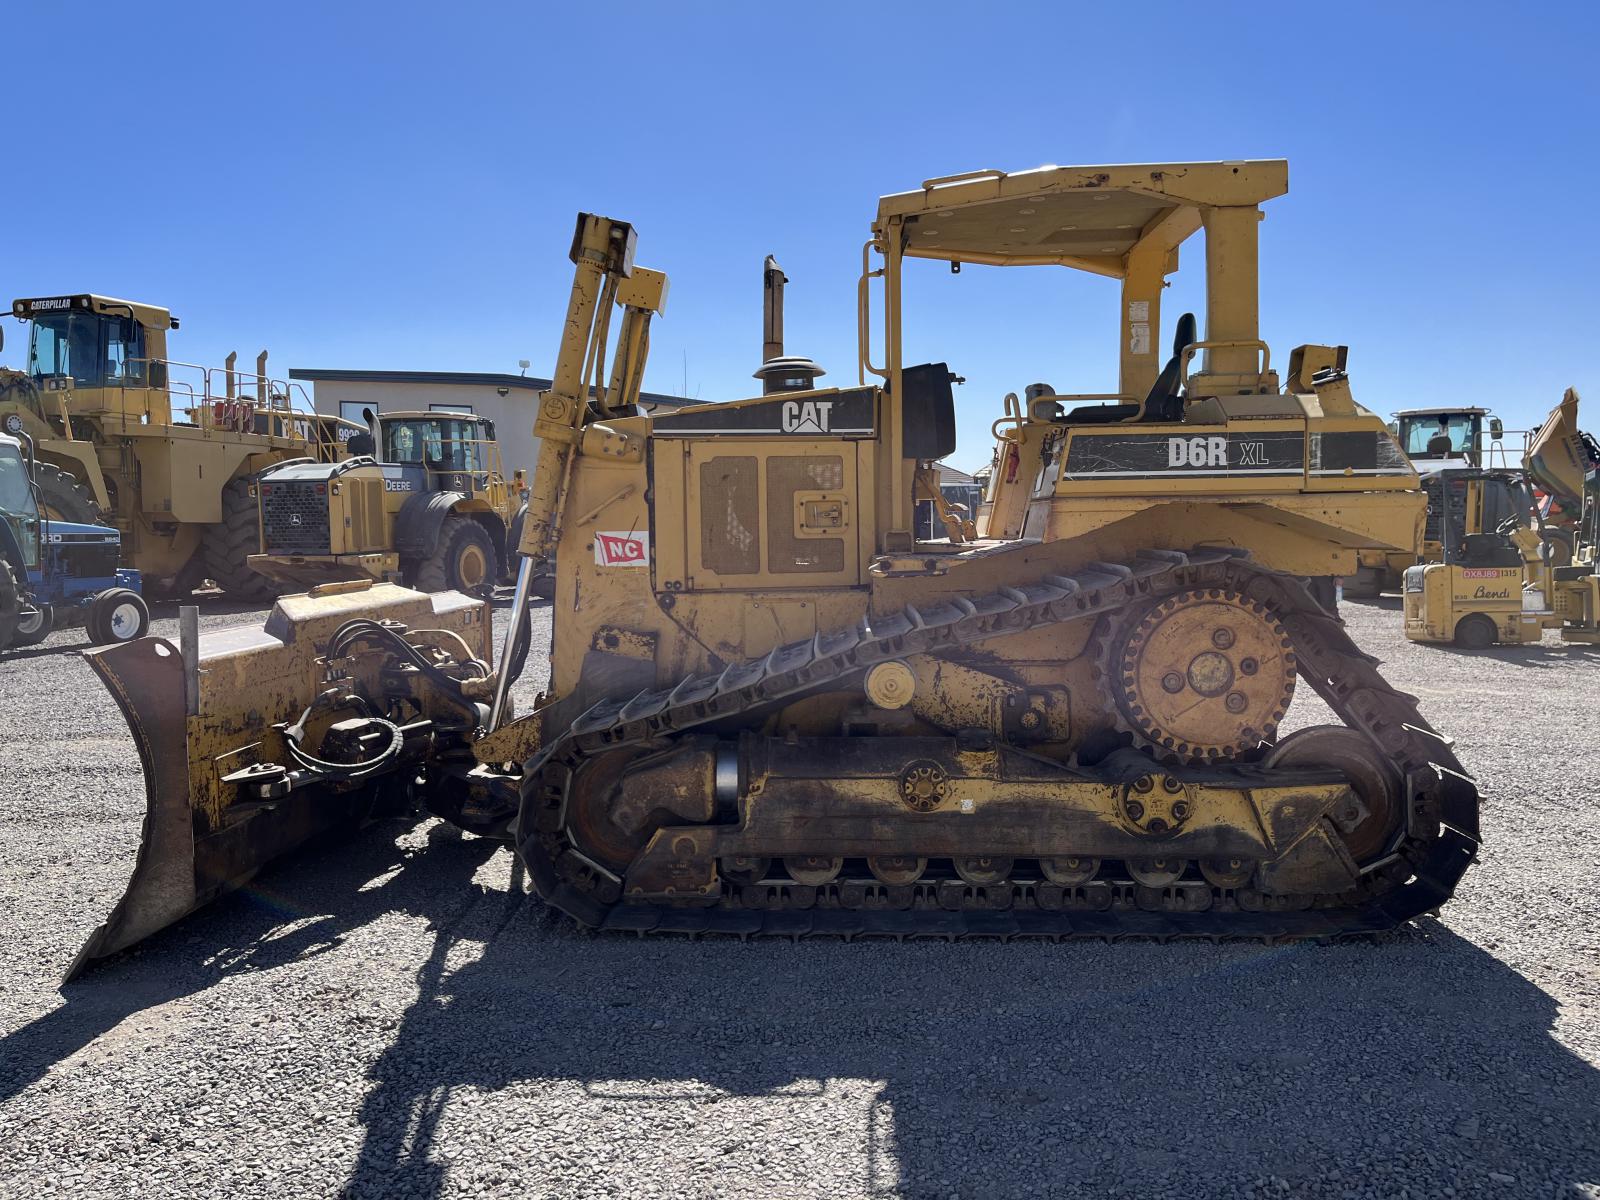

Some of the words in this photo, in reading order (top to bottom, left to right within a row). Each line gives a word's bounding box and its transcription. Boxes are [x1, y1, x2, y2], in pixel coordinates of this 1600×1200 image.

[31, 298, 71, 310] CATERPILLAR
[782, 401, 833, 433] CAT
[1168, 436, 1228, 467] D6R
[1239, 442, 1270, 465] XL
[385, 479, 411, 491] DEERE
[608, 541, 638, 558] NC
